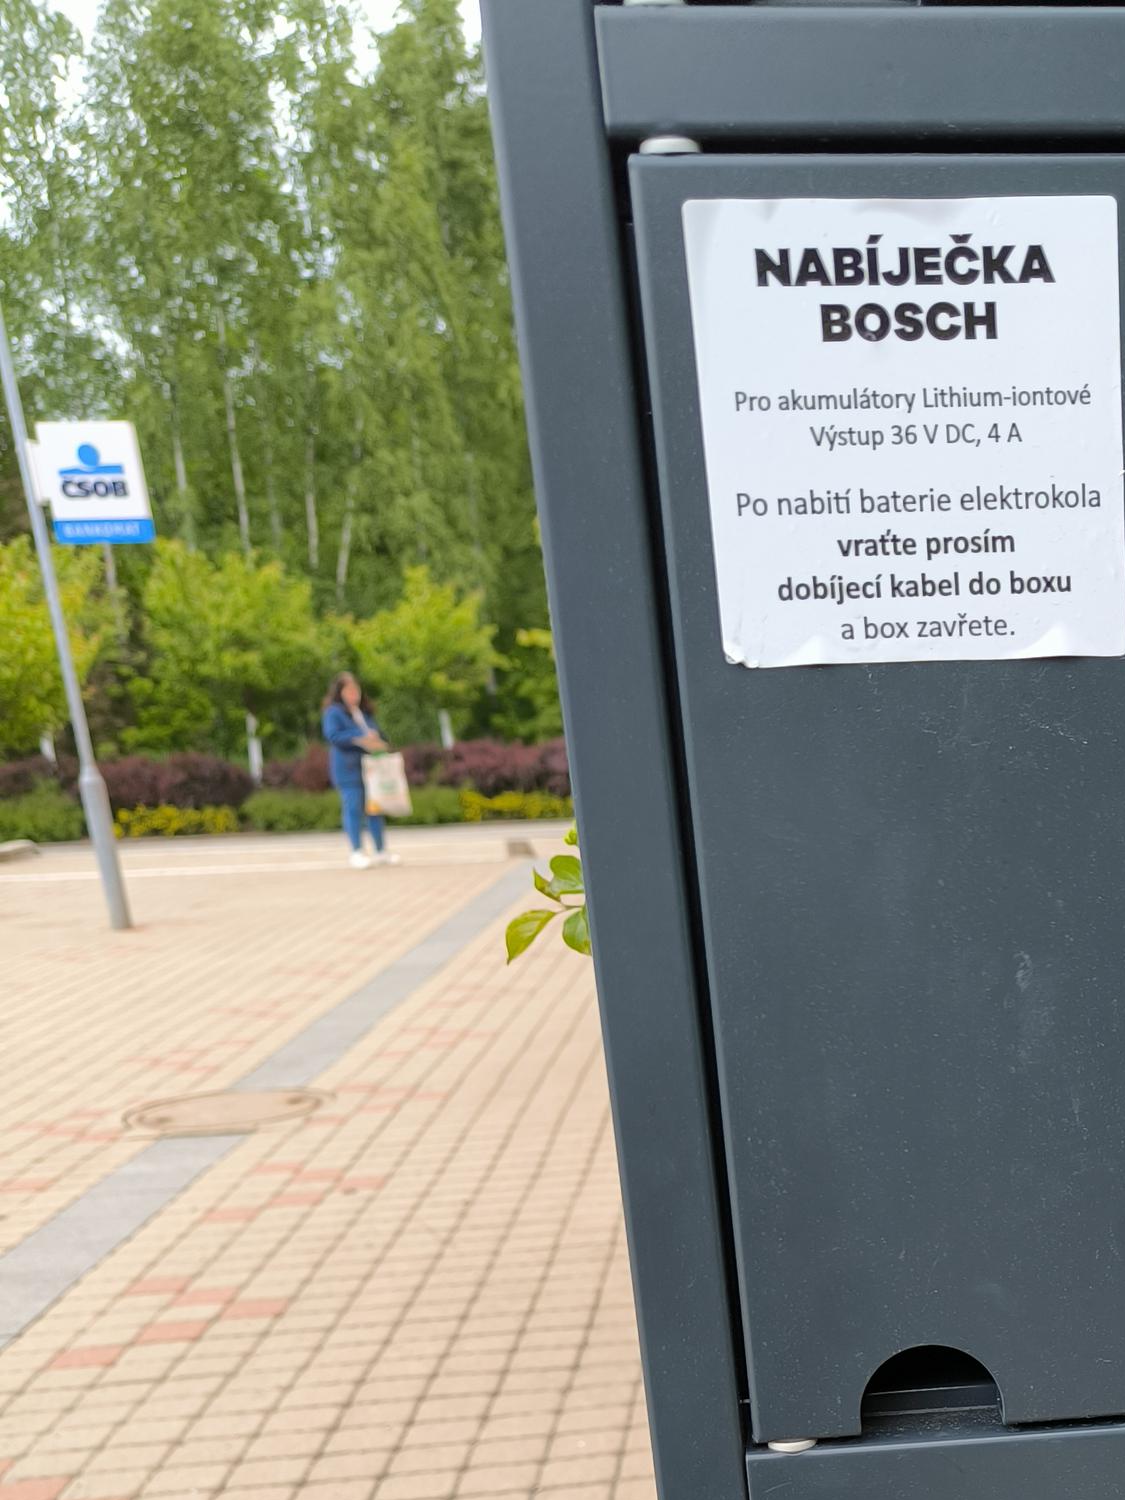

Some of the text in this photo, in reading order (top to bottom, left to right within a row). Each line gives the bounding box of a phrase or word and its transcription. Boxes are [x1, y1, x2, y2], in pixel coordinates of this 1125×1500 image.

[754, 233, 1055, 287] NABÍJEČKA
[820, 301, 998, 342] BOSCH
[734, 383, 1091, 414] Pro akumulátory Lithium-iontové
[809, 422, 1023, 451] Výstup 36 V DC, 4 A
[736, 482, 1101, 517] Po nabití baterie elektrokola
[836, 528, 1015, 561] vraťte prosím
[777, 570, 1071, 605] dobíjecí kabel do boxu
[841, 612, 1015, 640] a box zavřete.
